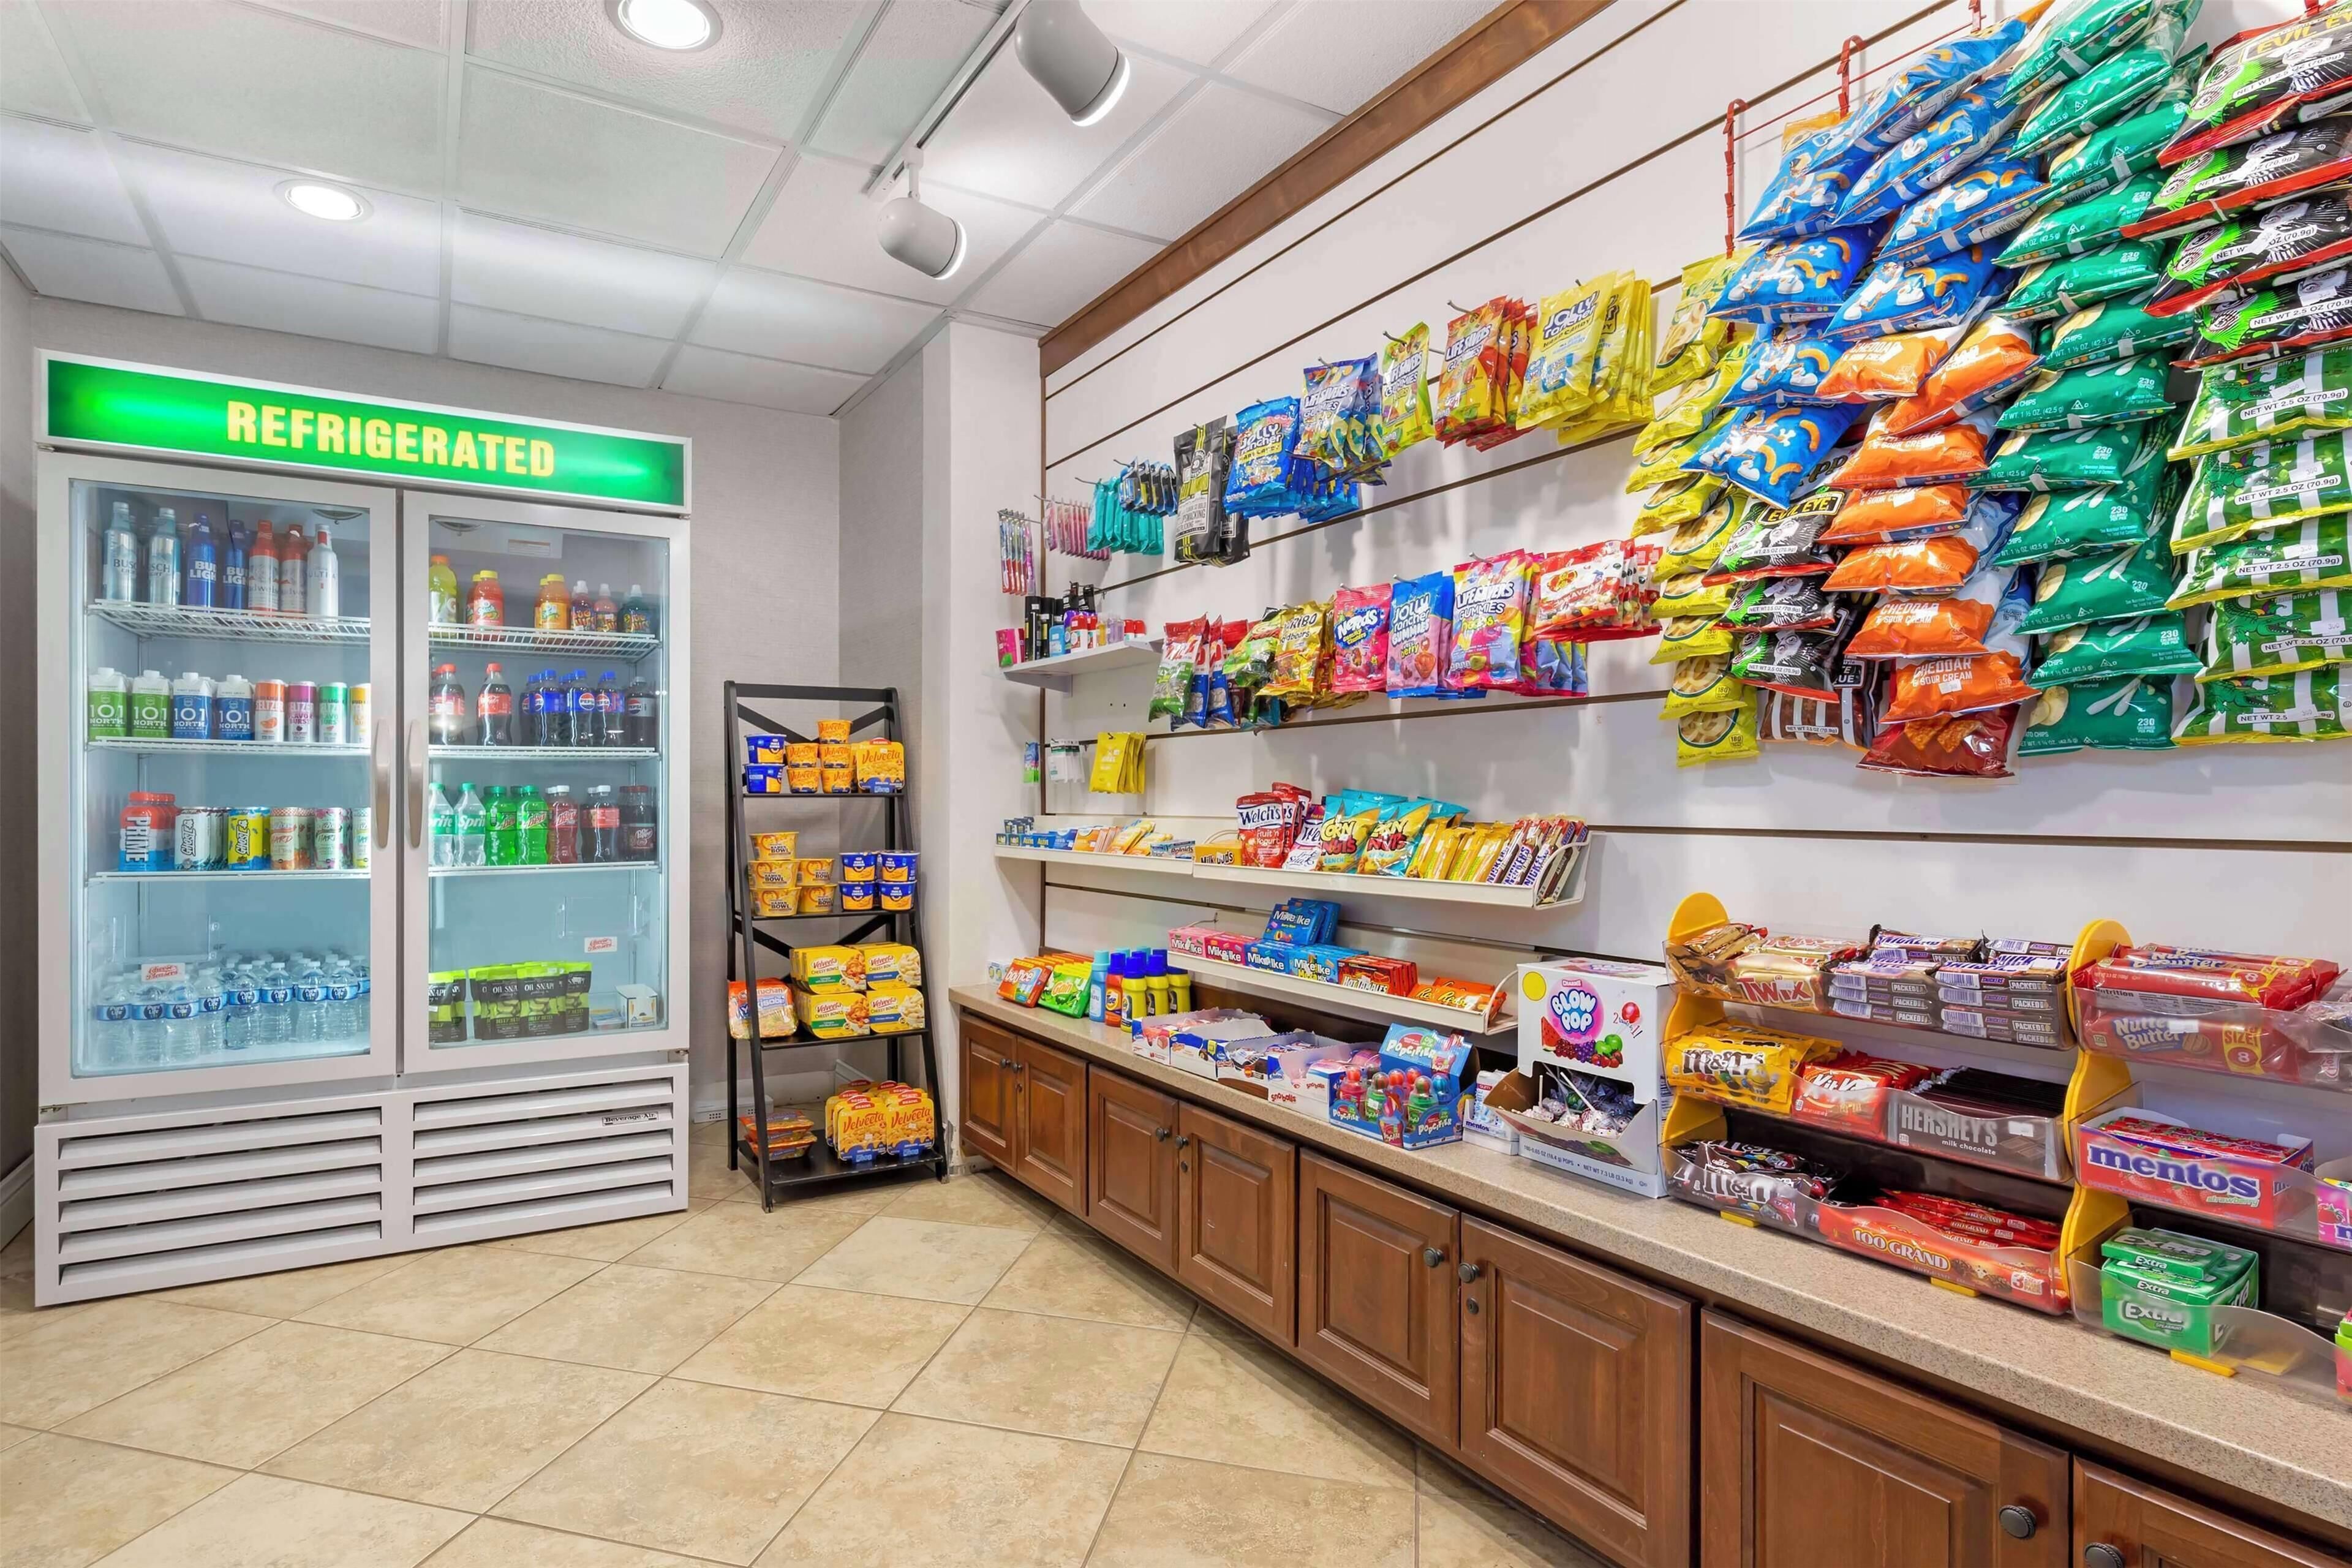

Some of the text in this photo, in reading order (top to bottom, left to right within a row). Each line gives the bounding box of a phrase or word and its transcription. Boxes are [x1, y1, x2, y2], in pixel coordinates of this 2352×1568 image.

[2257, 24, 2318, 55] EVIL
[1544, 290, 1600, 331] JOLLY
[2253, 303, 2324, 326] NET WT 2.5 OZ
[2064, 334, 2082, 344] CHIPS
[2054, 349, 2066, 357] WT.
[2091, 339, 2107, 348] (42.5
[2138, 377, 2155, 386] 230
[2043, 407, 2057, 415] (42.5
[2244, 390, 2346, 417] NET WT 2.5 OZ (70.9g)
[226, 399, 556, 477] REFRIGERATED
[2095, 446, 2113, 454] 230
[2238, 477, 2339, 503] NET WT 2.5 OZ (70.9g)
[1768, 497, 1831, 522] EVIL EYE
[2239, 565, 2257, 574] NET
[2259, 563, 2274, 571] WT
[2292, 559, 2307, 568] OZ
[2307, 556, 2340, 568] (70.9g)
[1392, 592, 1430, 624] JOLLY
[1458, 602, 1506, 621] GUMMIES
[1391, 619, 1430, 647] GUMMIES
[2160, 630, 2179, 638] 230
[1914, 658, 1972, 677] CHEDDAR
[1920, 671, 1973, 686] SOUR CREAM
[1717, 686, 1729, 695] 180
[90, 704, 124, 718] 101
[134, 706, 168, 720] 101
[173, 707, 206, 722] 101
[219, 709, 251, 724] 101
[862, 749, 900, 764] Velveeta
[1238, 805, 1281, 825] Welch's
[125, 816, 151, 864] PRIME
[1256, 829, 1273, 837] Fruit
[1256, 837, 1280, 846] Yogurt
[1296, 916, 1311, 927] Ike
[1190, 944, 1202, 955] Ike
[1227, 951, 1242, 962] Ike
[1270, 959, 1285, 970] Ike
[1316, 963, 1331, 976] Ike
[2245, 973, 2258, 982] 8
[1052, 982, 1072, 995] Gain
[2011, 981, 2038, 990] PACKED
[2096, 987, 2134, 998] Nutrition
[1106, 995, 1116, 1004] Tide
[1551, 989, 1597, 1016] BLOW
[2014, 1000, 2040, 1008] PACKED
[1560, 1012, 1593, 1033] POP
[1898, 1013, 1921, 1022] PACKED
[2015, 1022, 2041, 1031] PACKED
[2114, 1017, 2171, 1035] Nutte
[2122, 1029, 2180, 1050] Butter
[2237, 1051, 2250, 1063] 8
[843, 1112, 884, 1134] Velveeta
[891, 1107, 931, 1129] Velveeta
[1901, 1104, 1998, 1147] HERSHEY'S
[1465, 1120, 1490, 1133] mentos
[1959, 1142, 1996, 1156] chocolate
[1562, 1157, 1574, 1166] POPS
[2088, 1144, 2261, 1200] mentos
[1625, 1175, 1634, 1185] kg)
[2206, 1195, 2260, 1207] strawberry
[1853, 1227, 1951, 1271] 100 GRAND
[2135, 1255, 2168, 1270] Extra
[2136, 1280, 2170, 1295] Extra
[2124, 1301, 2184, 1324] Extra
